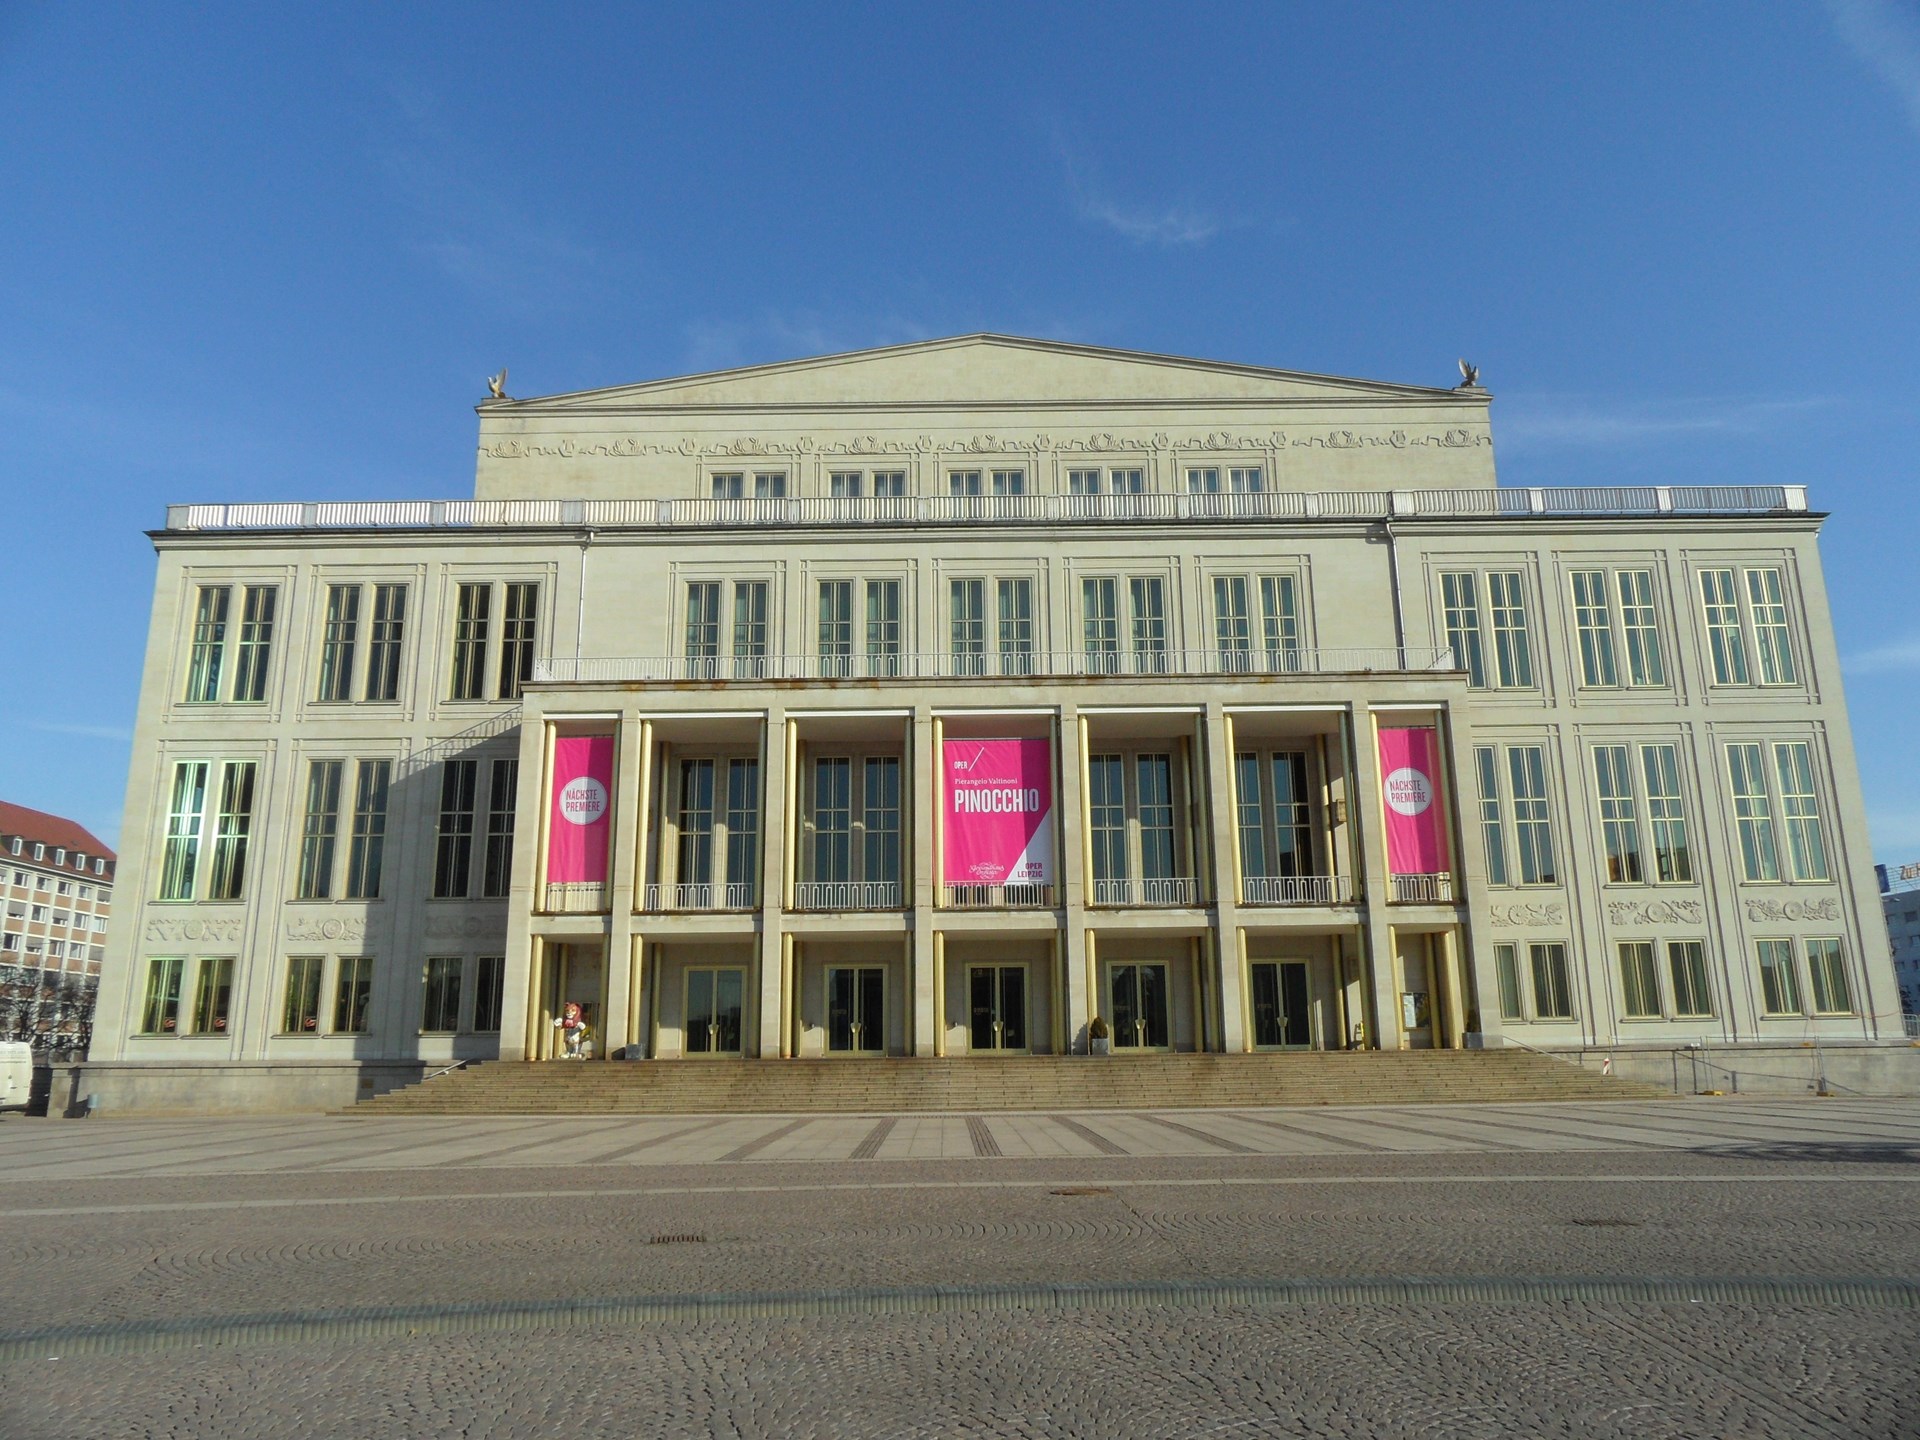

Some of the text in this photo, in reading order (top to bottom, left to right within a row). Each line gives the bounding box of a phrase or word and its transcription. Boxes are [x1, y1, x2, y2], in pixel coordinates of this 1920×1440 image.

[954, 761, 968, 770] OPER
[955, 778, 987, 786] Pierangelo
[1389, 778, 1421, 791] NÄCHSTE
[566, 788, 597, 800] NÄCHSTE
[1391, 792, 1427, 803] PREMIERE
[954, 789, 1039, 812] PINOCCHIO
[566, 801, 600, 812] PREMIERE
